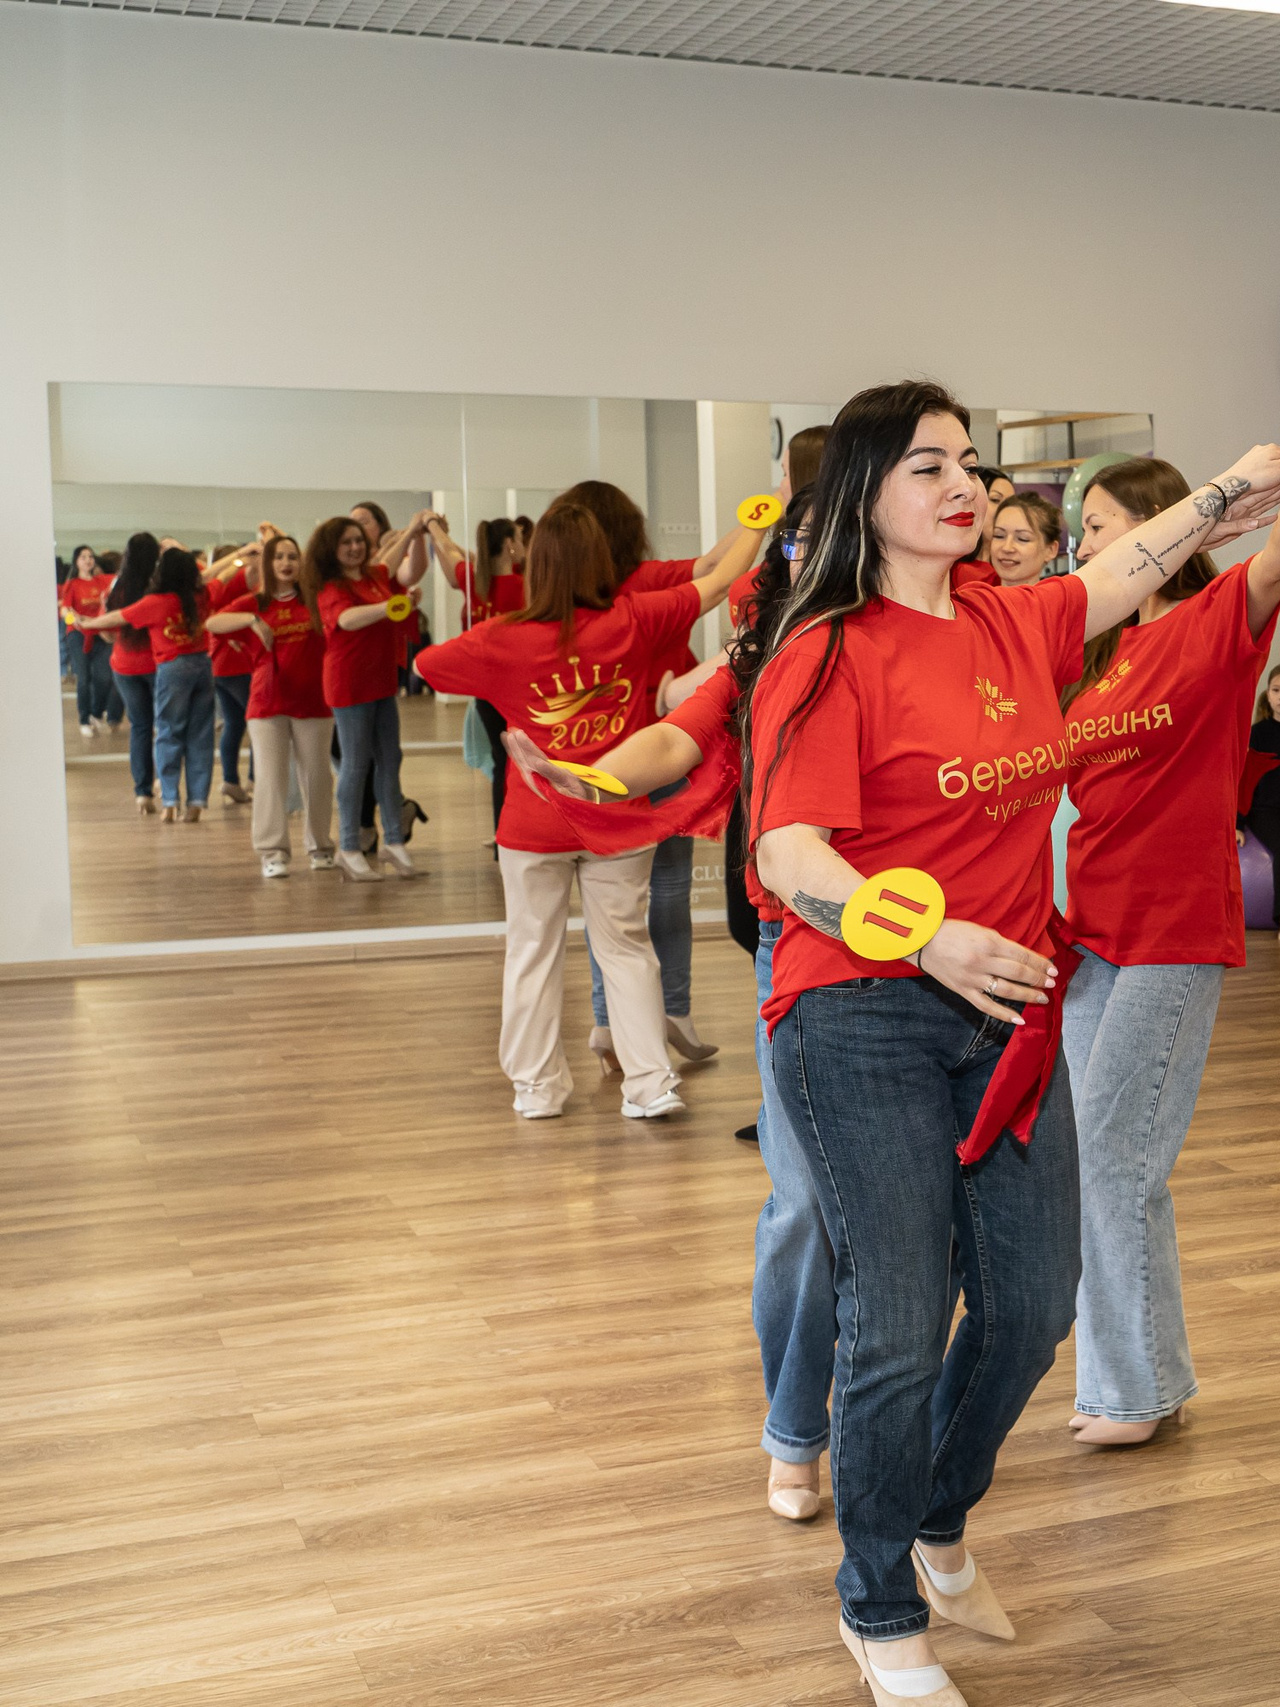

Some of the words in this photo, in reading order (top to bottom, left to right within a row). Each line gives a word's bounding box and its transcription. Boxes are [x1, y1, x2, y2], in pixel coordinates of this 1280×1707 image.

[547, 705, 628, 750] 2026
[1065, 703, 1173, 751] региня
[862, 888, 930, 938] 11
